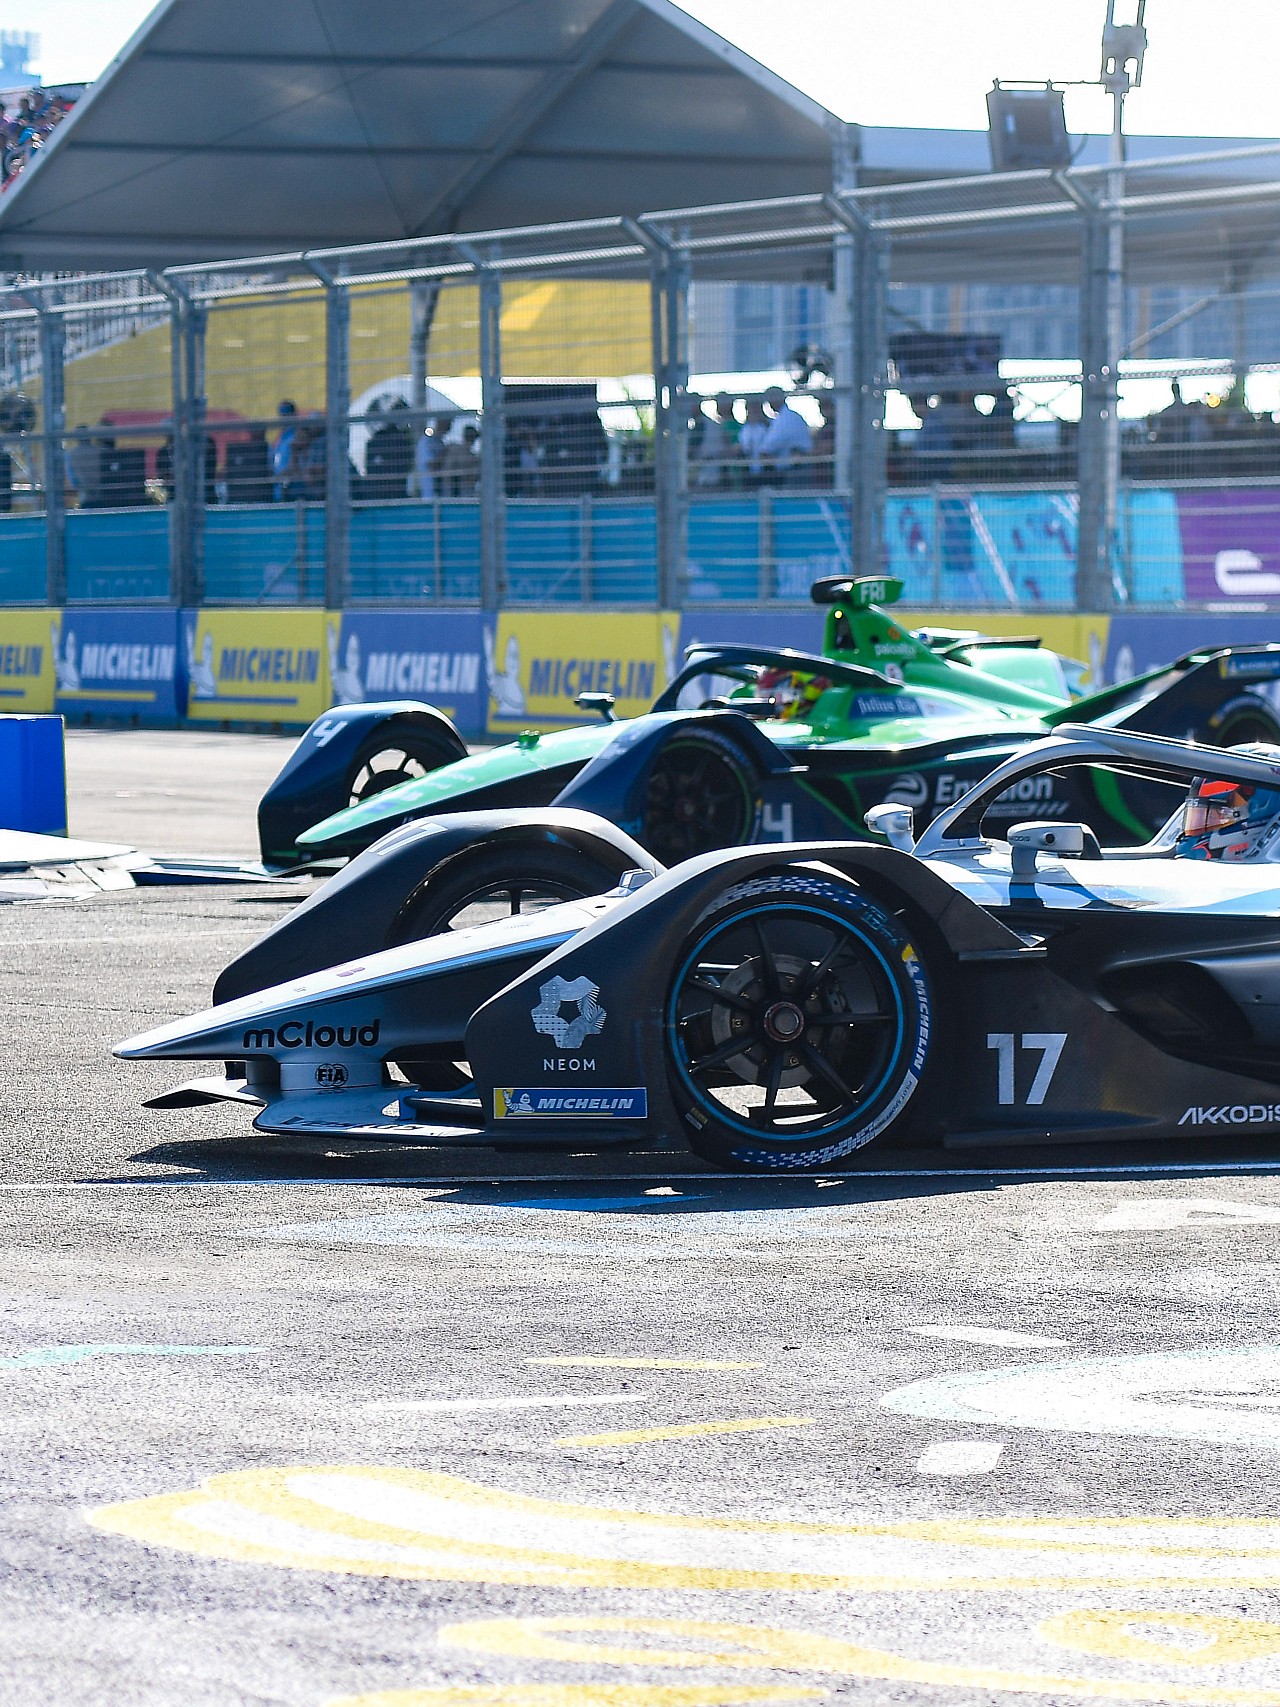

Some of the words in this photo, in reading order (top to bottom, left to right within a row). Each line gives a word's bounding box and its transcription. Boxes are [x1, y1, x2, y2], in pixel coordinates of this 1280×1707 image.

[860, 581, 886, 604] FRI
[0, 644, 43, 677] ELIN
[81, 644, 176, 680] MICHELIN
[219, 647, 319, 684] MICHELIN
[367, 652, 481, 693] MICHELIN
[529, 658, 656, 700] MICHELIN
[312, 719, 349, 748] 4
[762, 801, 794, 842] 4
[243, 1018, 380, 1050] mCloud
[914, 978, 930, 1071] MICHELIN
[542, 1058, 597, 1072] NEOM
[986, 1032, 1068, 1106] 17
[536, 1095, 635, 1111] MICHELIN
